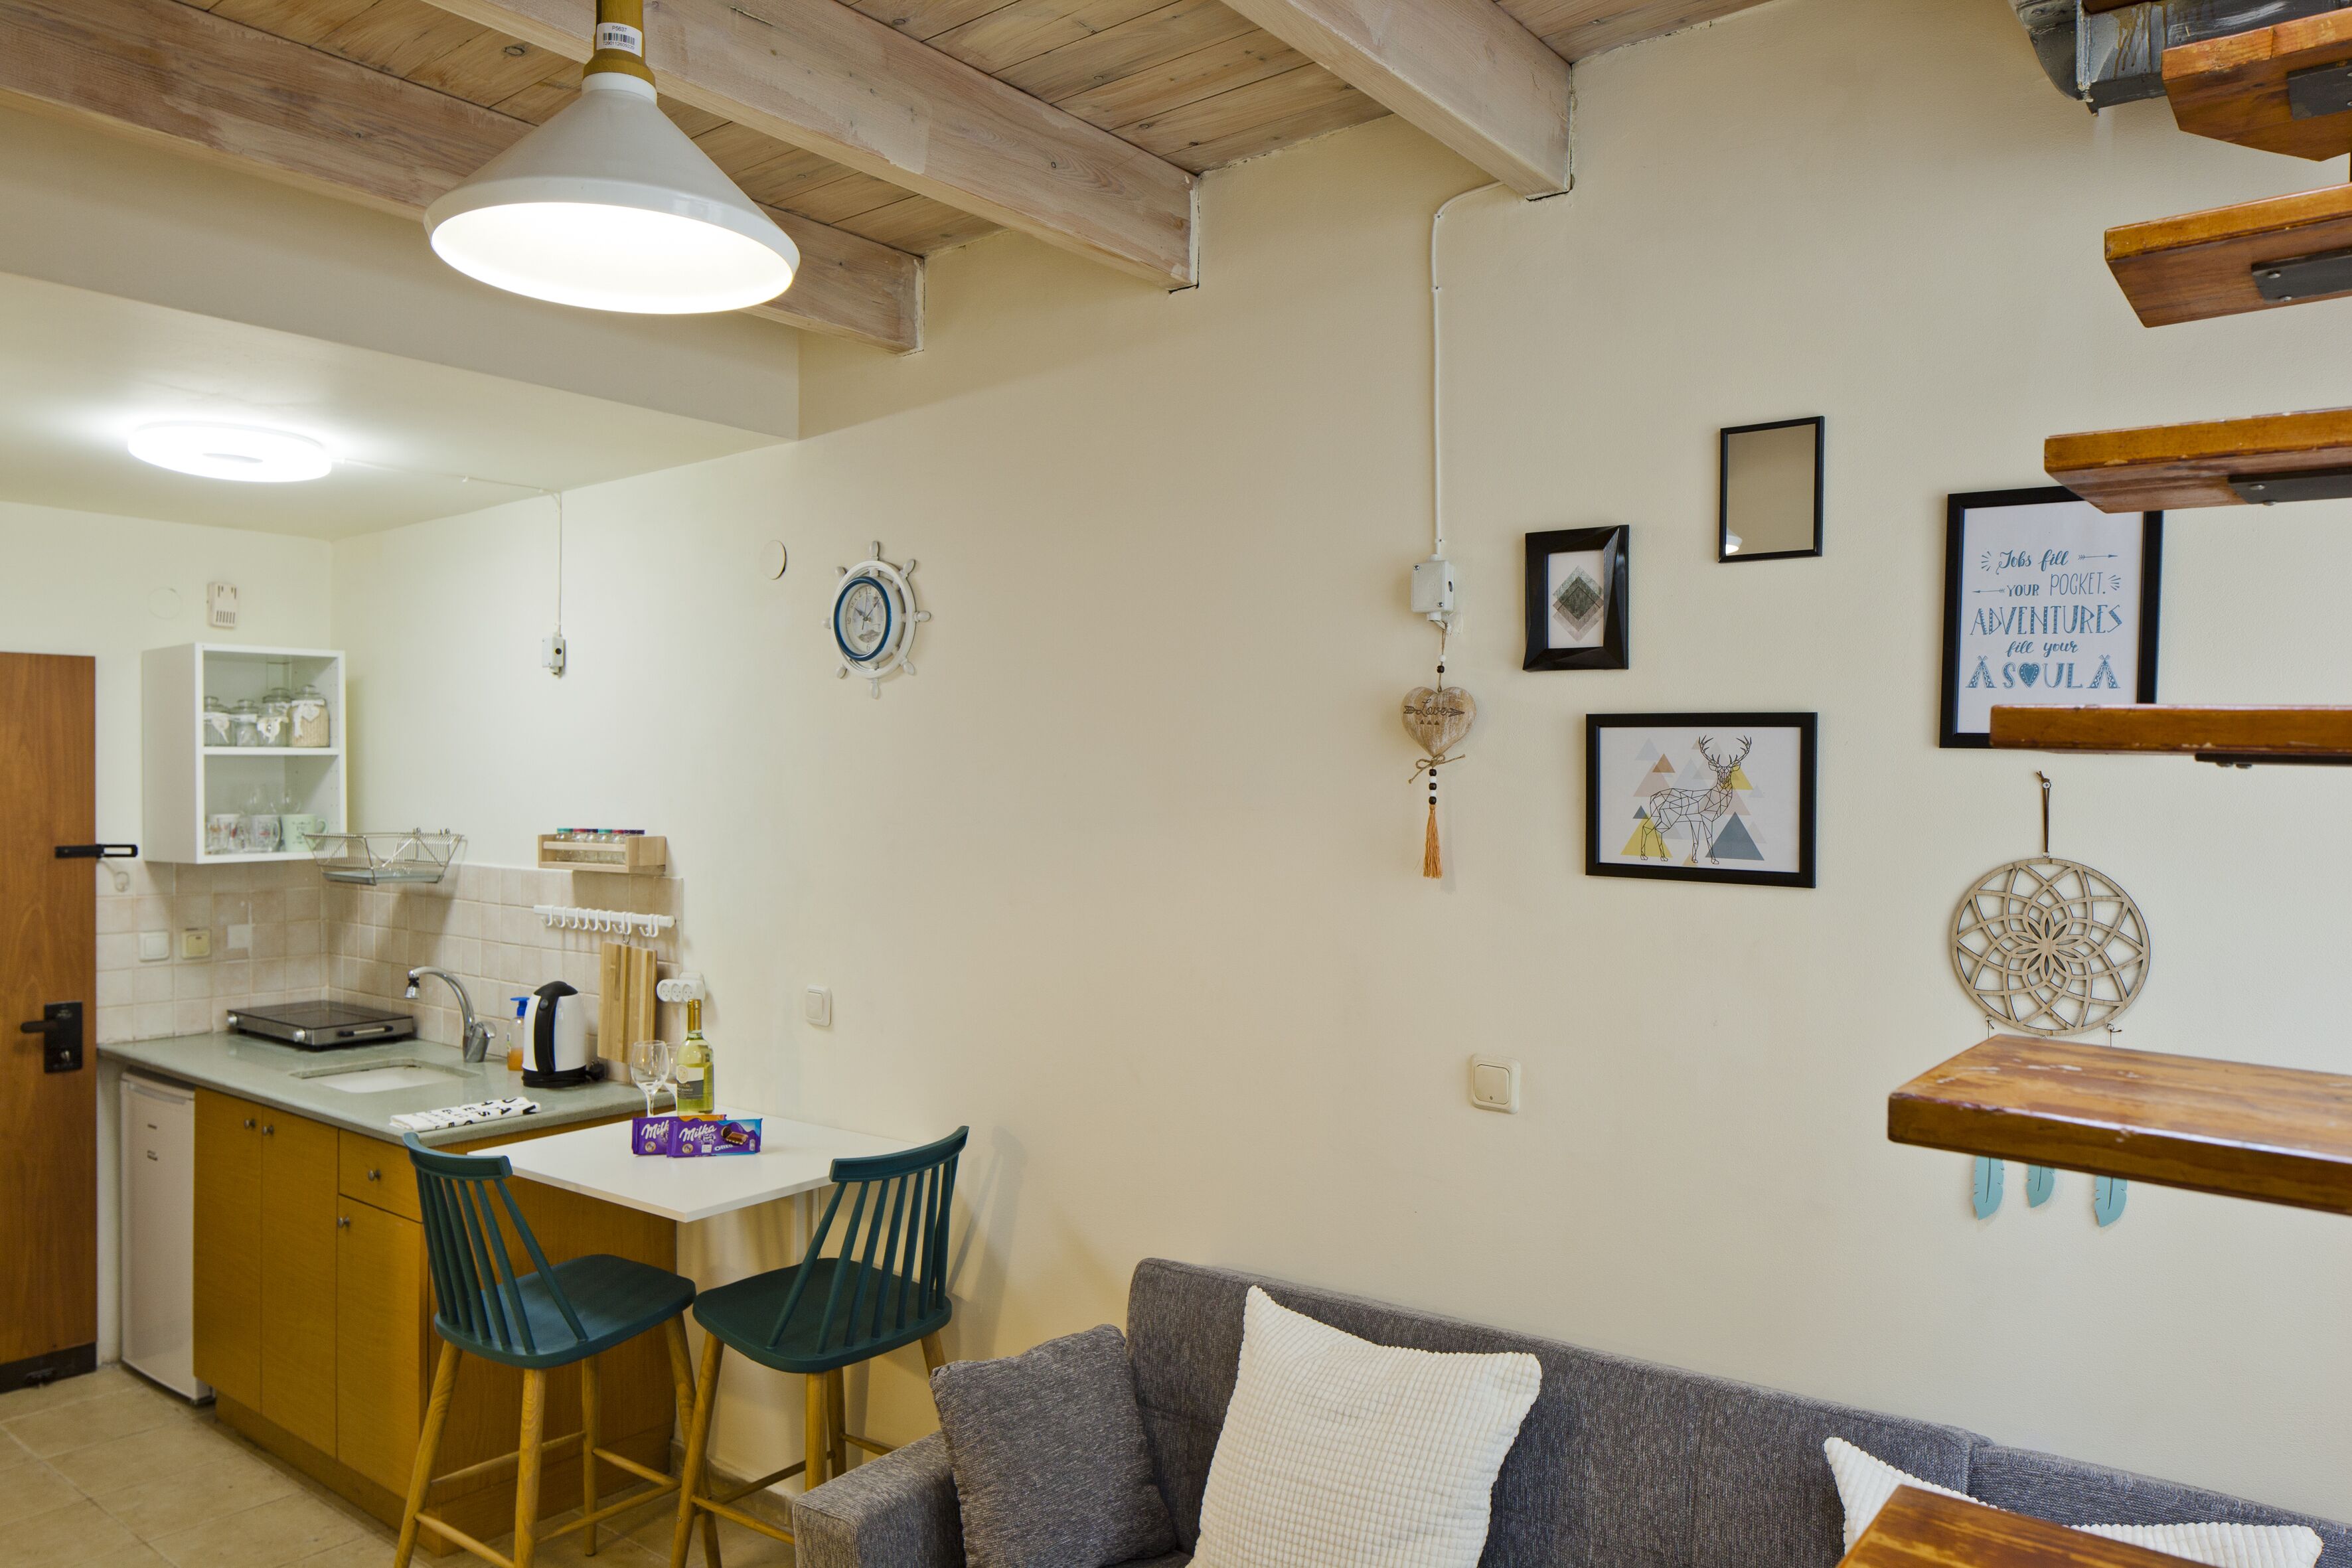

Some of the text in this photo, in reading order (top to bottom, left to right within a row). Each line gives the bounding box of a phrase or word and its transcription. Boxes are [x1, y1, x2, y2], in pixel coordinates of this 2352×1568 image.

[1996, 549, 2070, 575] Jobs fill
[2007, 572, 2106, 597] YOUR POCKET.
[1970, 604, 2123, 635] ADVENTURES
[2005, 640, 2078, 658] fill your
[1415, 698, 1449, 718] Love
[678, 1124, 717, 1142] Milka
